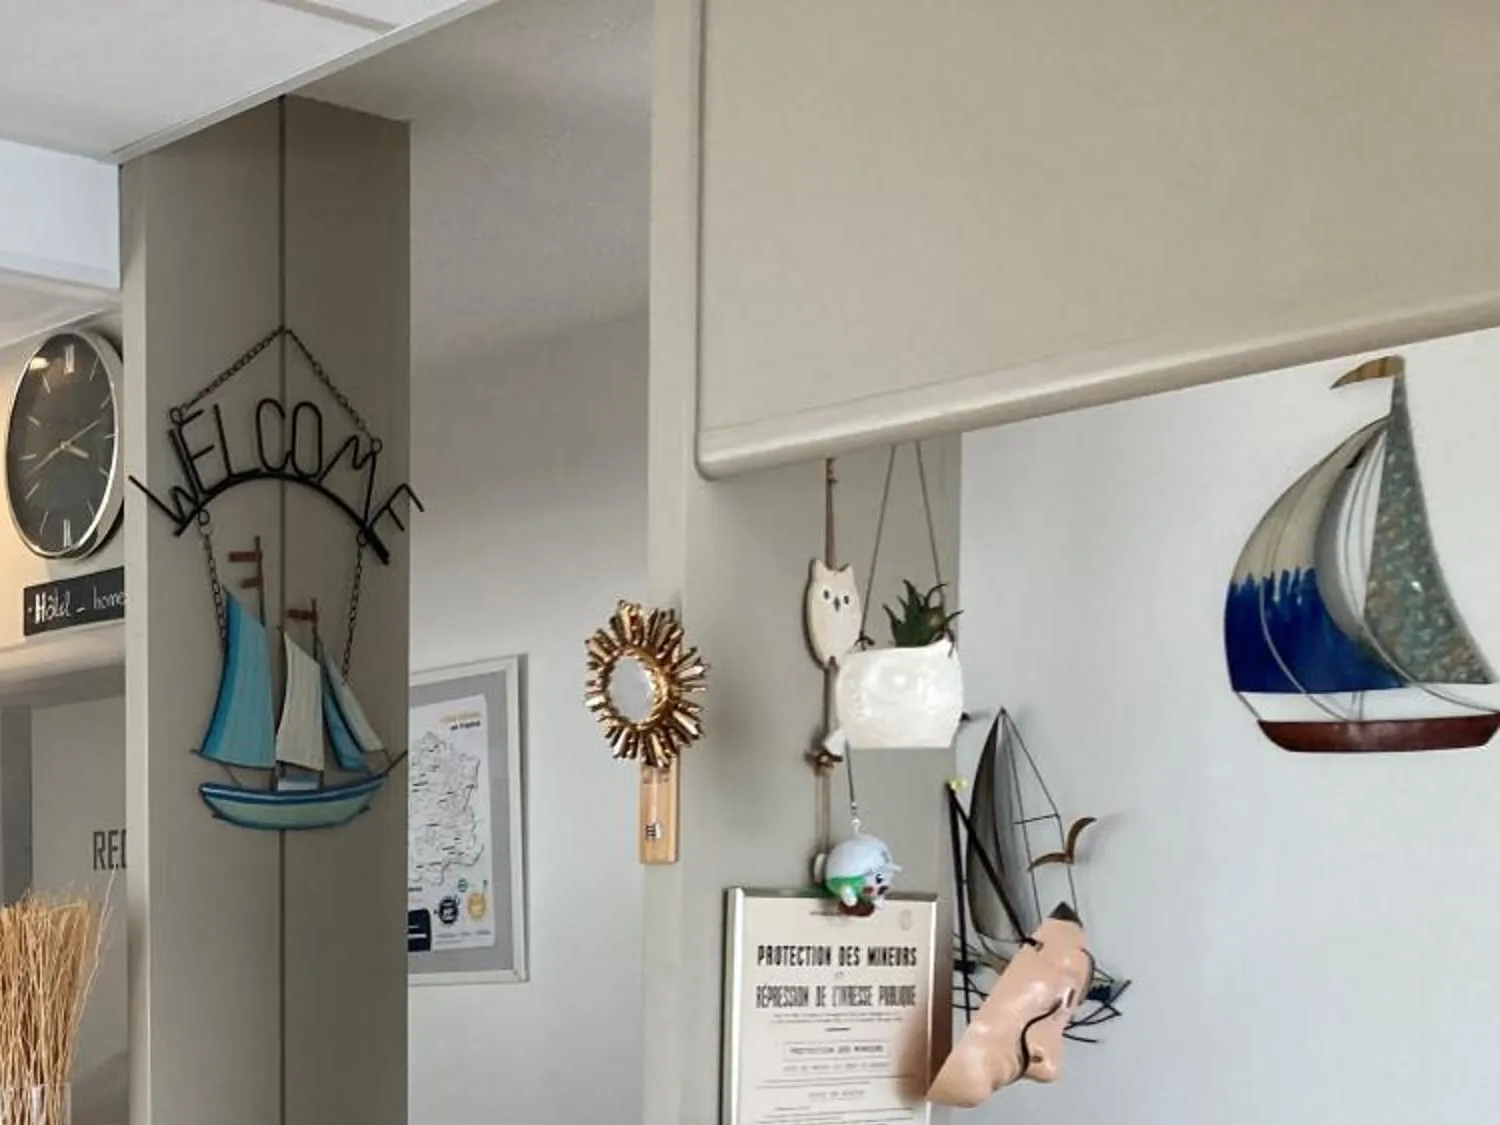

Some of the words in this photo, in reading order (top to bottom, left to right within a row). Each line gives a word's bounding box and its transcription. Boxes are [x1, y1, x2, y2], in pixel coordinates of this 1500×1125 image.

[128, 398, 425, 564] WELCOME
[757, 945, 831, 966] PROTECTION
[838, 945, 860, 966] DES
[867, 946, 917, 966] MINEURS
[816, 985, 826, 1007] DE
[878, 985, 916, 1008] PUBLIQUE
